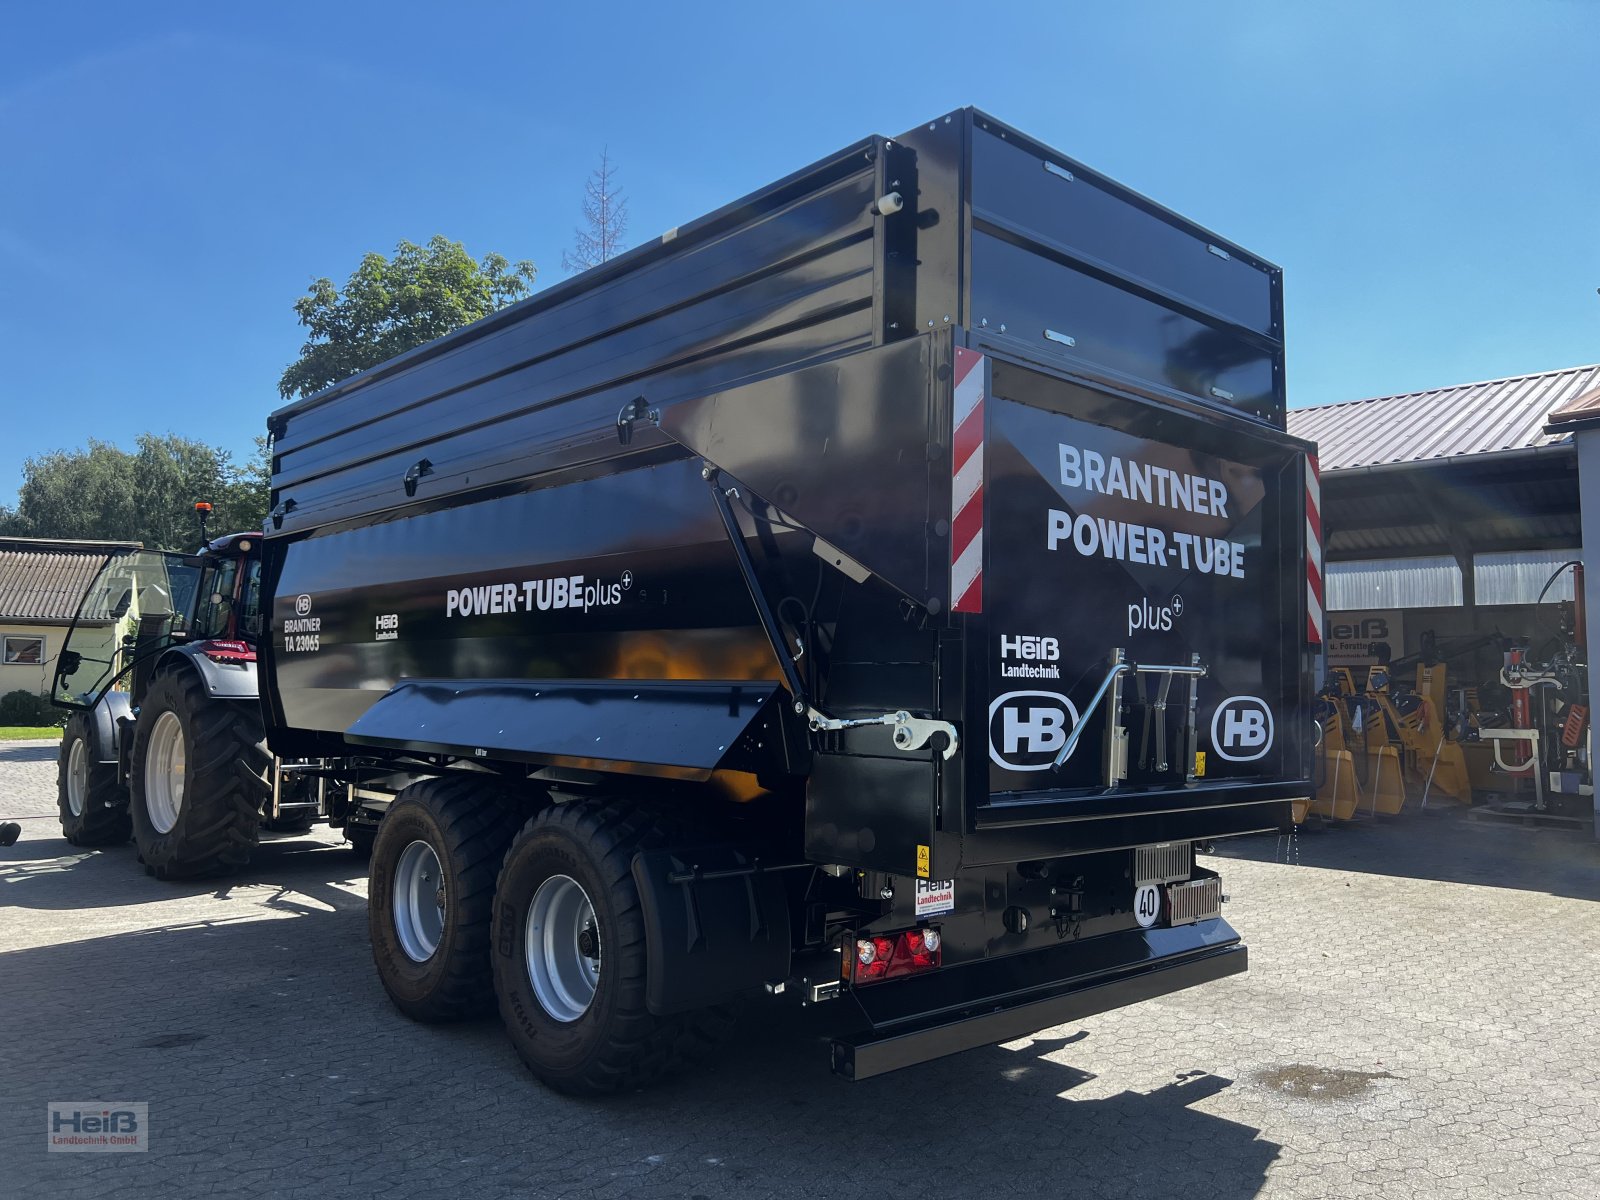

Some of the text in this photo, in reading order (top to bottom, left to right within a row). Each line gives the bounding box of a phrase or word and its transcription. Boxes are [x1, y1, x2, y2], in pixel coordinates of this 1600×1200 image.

[1058, 443, 1229, 518] BRANTNER
[1047, 508, 1245, 579] POWER-TUBE
[284, 618, 321, 633] BRANTNER
[375, 614, 399, 630] Heiß
[284, 634, 320, 652] TA 23065
[1001, 634, 1060, 661] Heiß
[1001, 662, 1060, 679] Landtechnik
[1003, 707, 1067, 754] HB
[1224, 709, 1266, 748] HB
[917, 892, 953, 905] Landtechnik
[1140, 889, 1155, 917] 40
